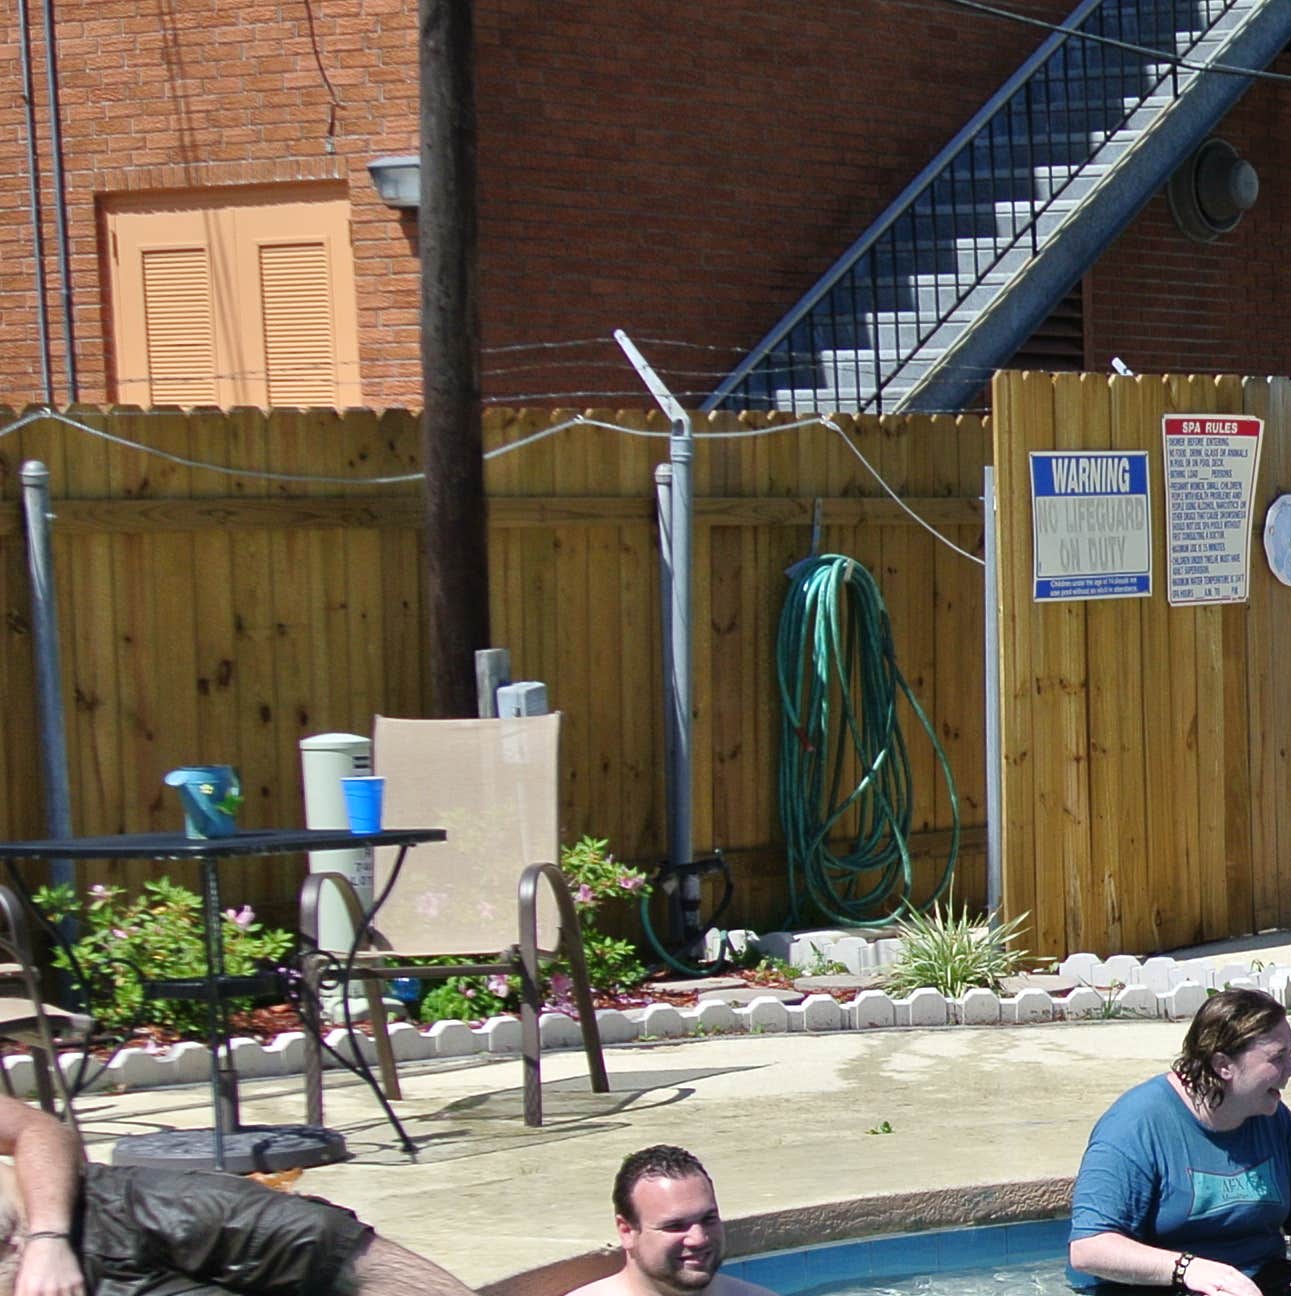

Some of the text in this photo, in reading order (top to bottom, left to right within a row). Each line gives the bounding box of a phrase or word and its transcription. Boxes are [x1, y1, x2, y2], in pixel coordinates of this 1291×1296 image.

[1182, 421, 1238, 434] SPA RULES
[1051, 457, 1130, 494] WARNING
[1038, 497, 1144, 534] NO LIFEGUARD
[1060, 536, 1126, 571] ON DUTY
